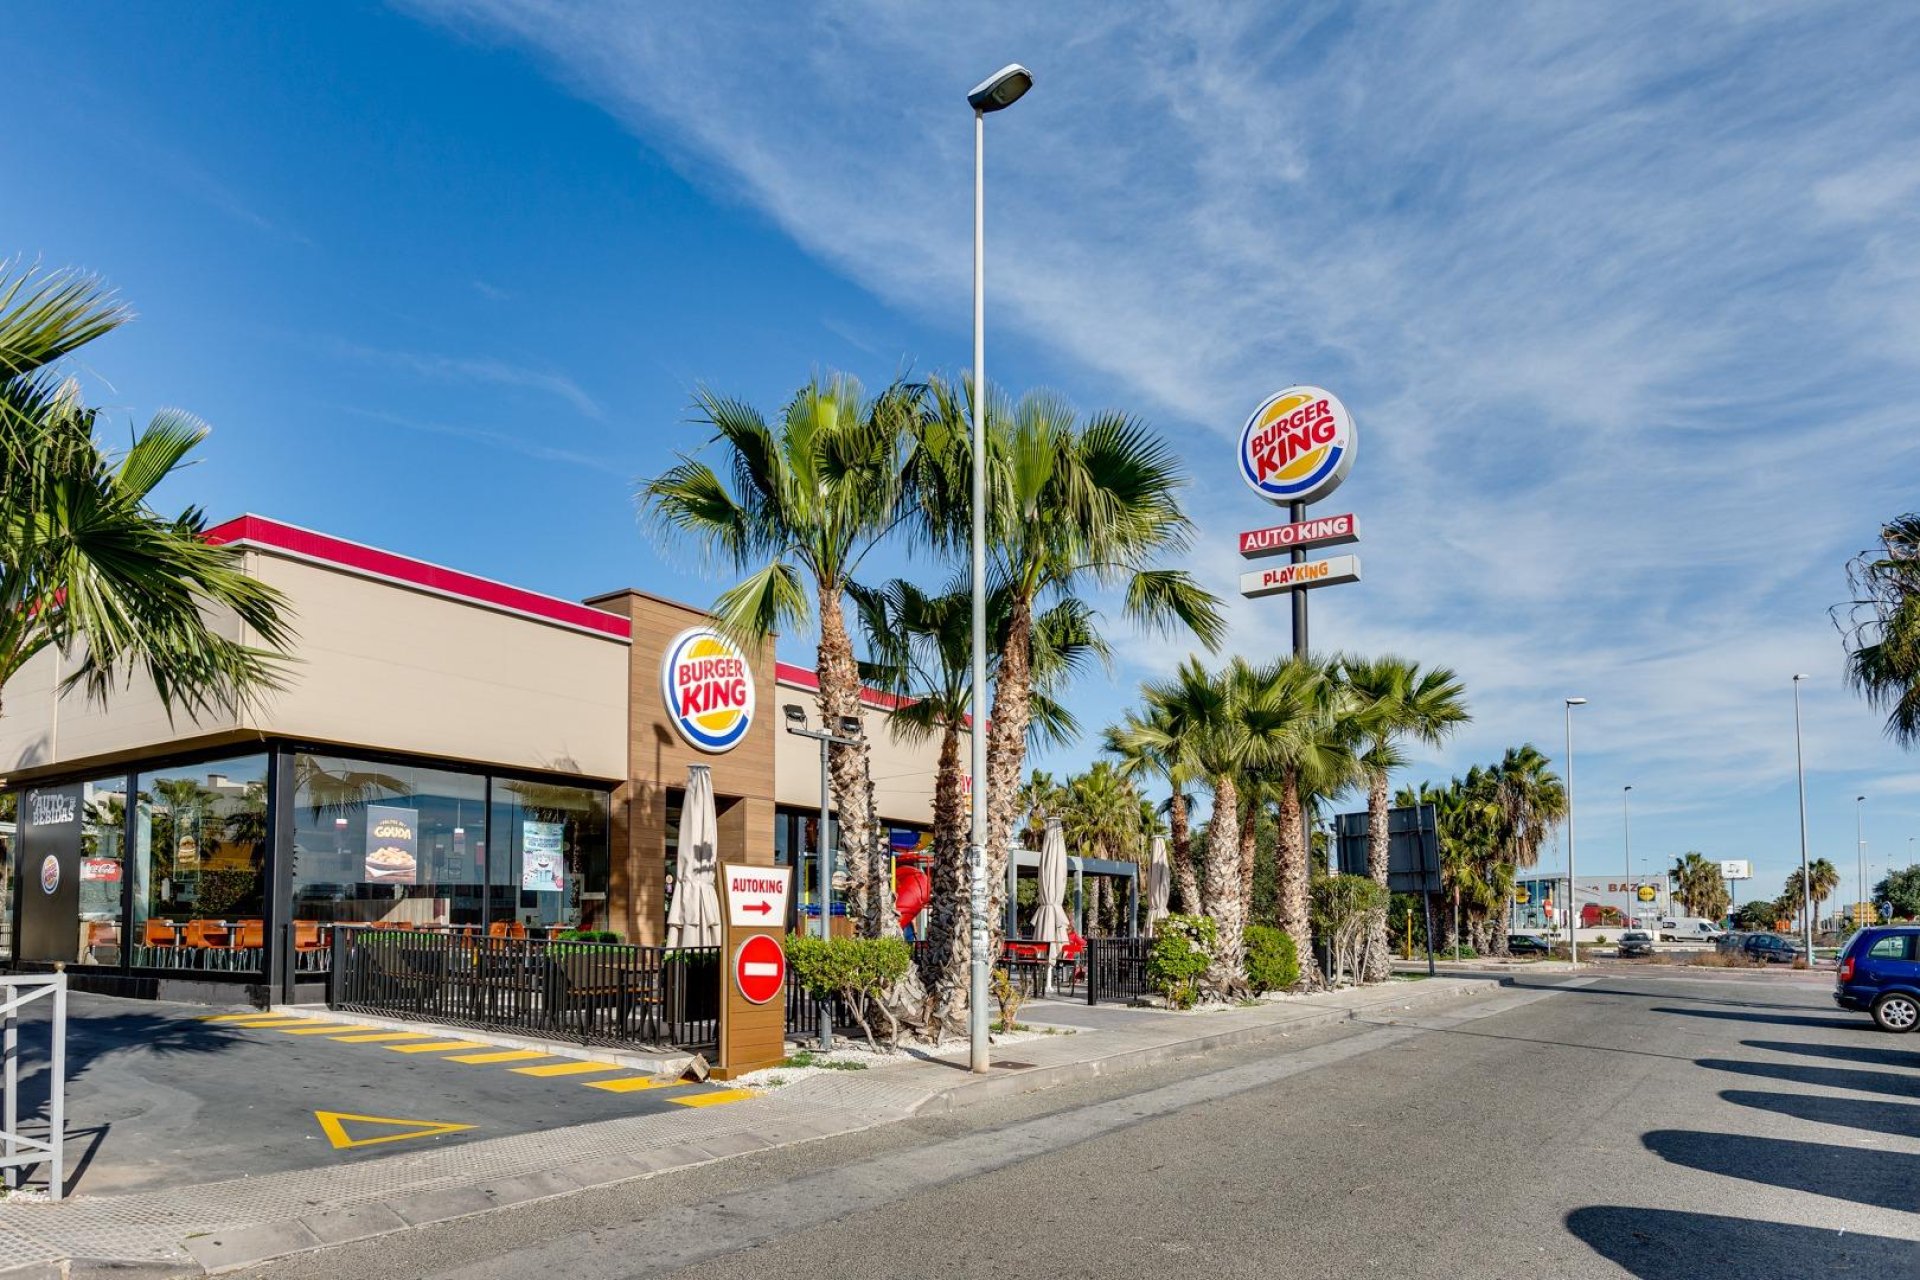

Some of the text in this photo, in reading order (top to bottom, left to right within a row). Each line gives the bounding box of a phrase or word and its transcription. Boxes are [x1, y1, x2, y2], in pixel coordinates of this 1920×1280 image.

[1251, 399, 1331, 458] BURGER
[1256, 415, 1336, 482] KING
[1245, 517, 1348, 550] AUTO KING
[1263, 562, 1328, 586] PLAYKING
[679, 658, 744, 686] BURGER
[681, 679, 746, 717] KING
[35, 794, 64, 812] AUTO
[33, 808, 75, 825] BEBIDAS
[374, 825, 411, 840] GOUDA
[732, 878, 783, 894] AUTOKING
[1607, 882, 1662, 892] BAZR
